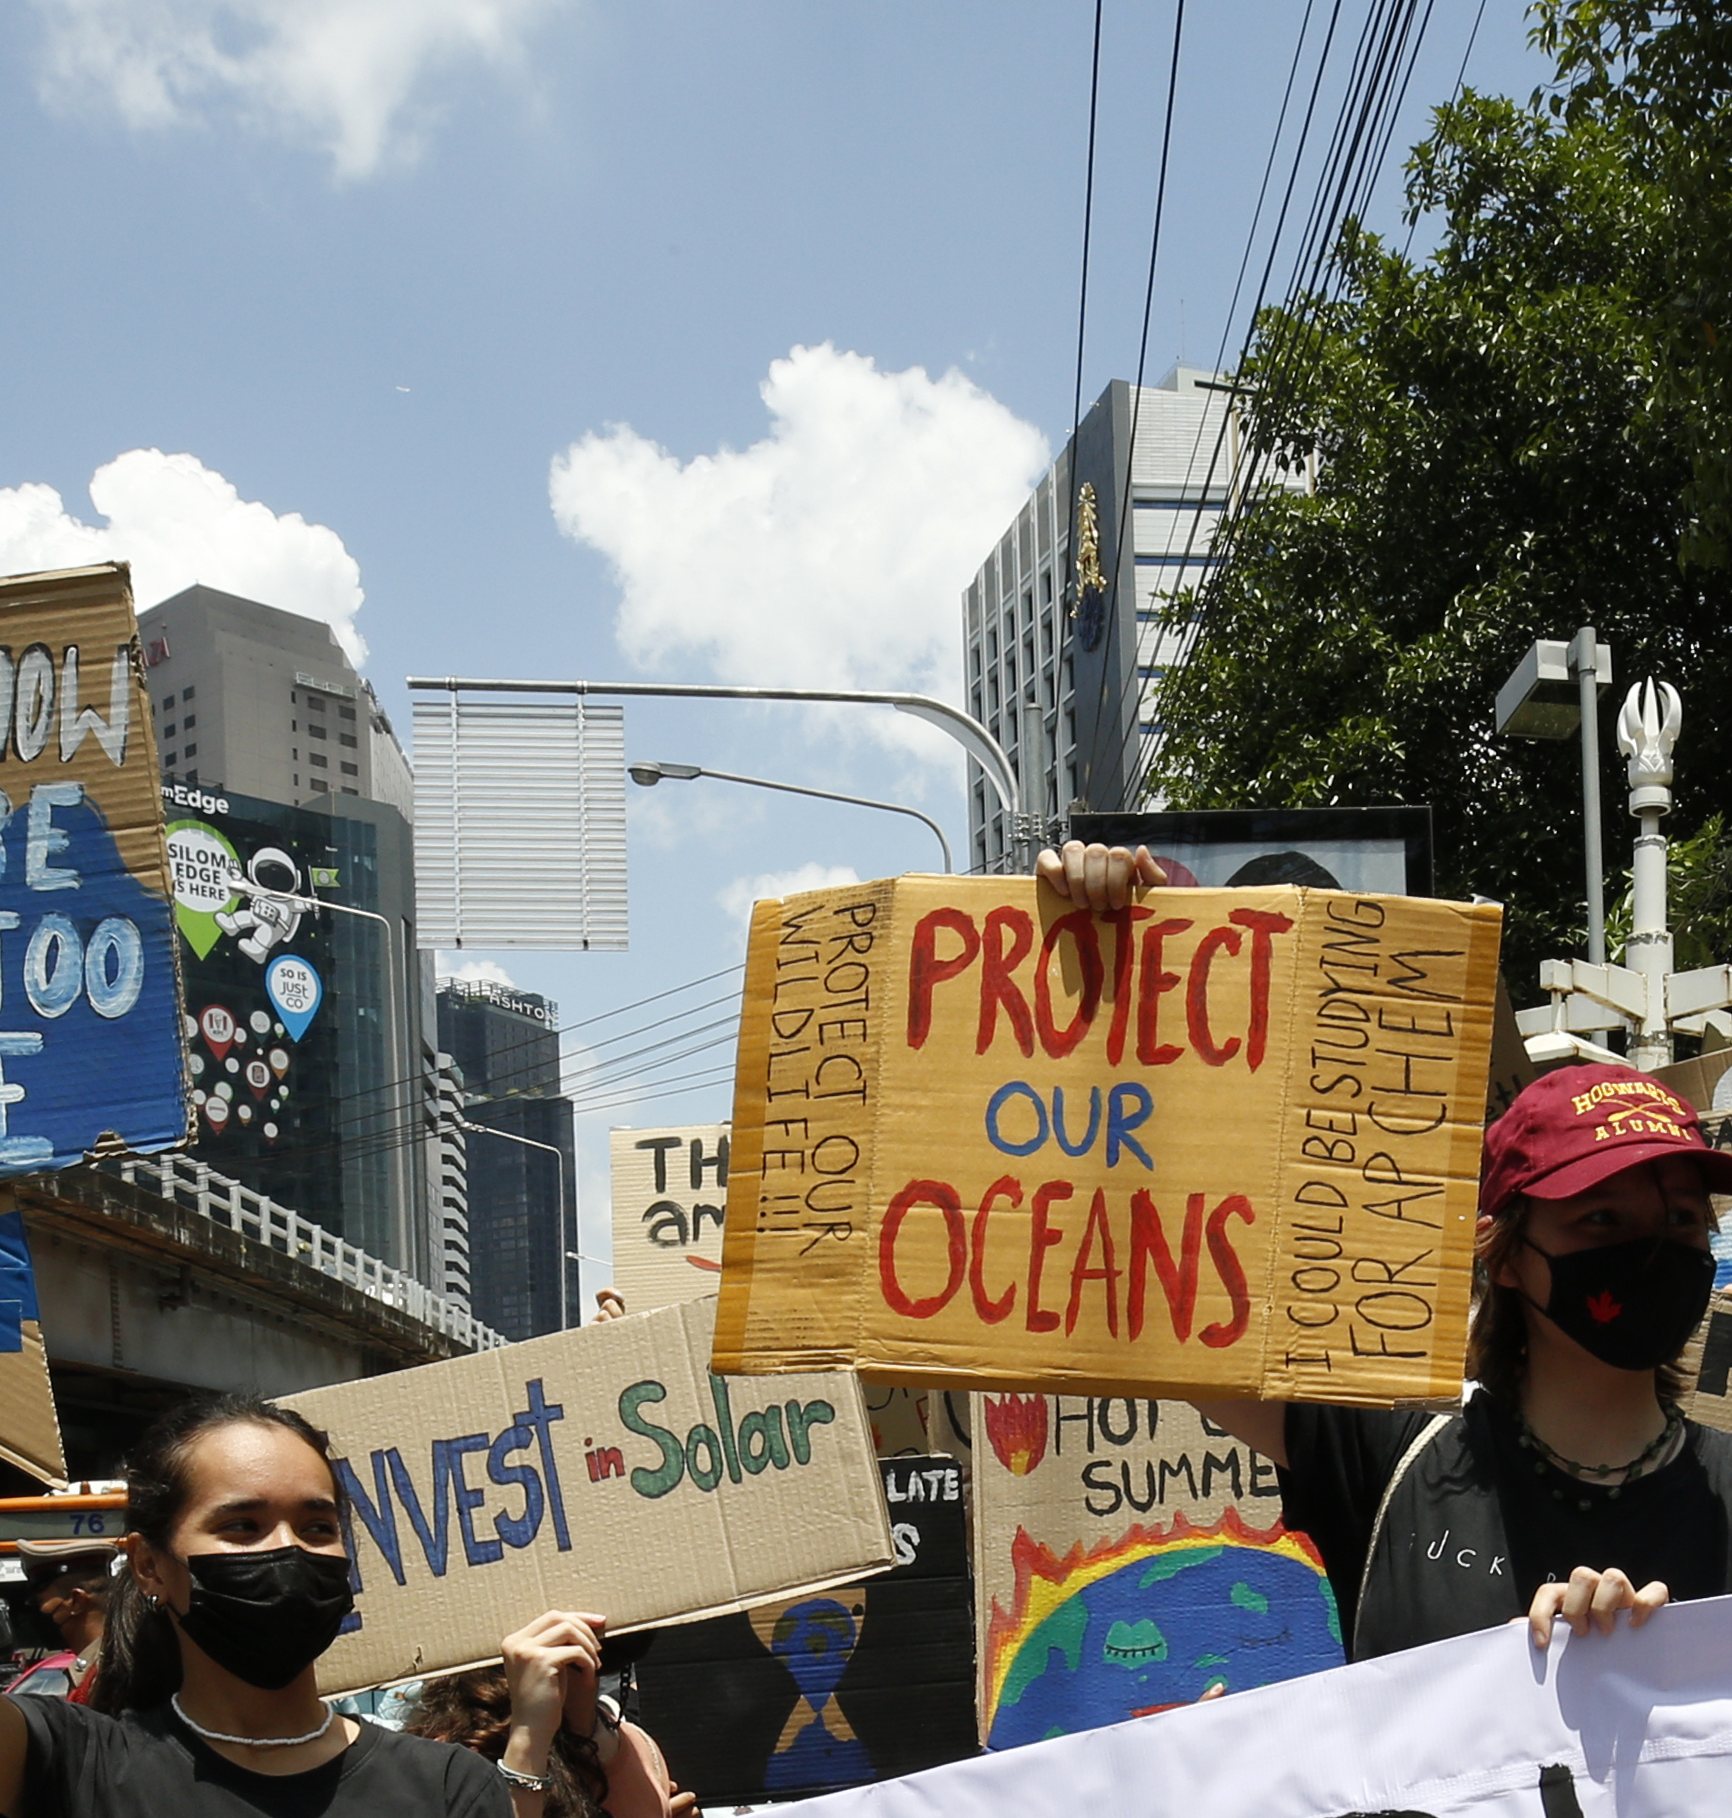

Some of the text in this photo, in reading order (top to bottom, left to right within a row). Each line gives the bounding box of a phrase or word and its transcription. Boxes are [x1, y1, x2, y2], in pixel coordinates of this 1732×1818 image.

[168, 843, 226, 869] SILOM
[175, 862, 222, 886] EDGE
[189, 882, 226, 902] HERE
[279, 967, 308, 982] SO IS
[906, 904, 1295, 1074] PROTECT
[1311, 899, 1386, 1102] STUDYING
[488, 992, 559, 1024] ASHTON
[755, 902, 828, 1236] WILDLIFE!!!
[798, 902, 877, 1258] PROTECT OUR
[1571, 1082, 1687, 1116] HOGWARTS
[984, 1080, 1156, 1171] OUR
[1302, 1108, 1357, 1165] BE
[1595, 1119, 1692, 1141] ALUMNI
[1348, 946, 1466, 1359] FOR AP CHEM
[877, 1174, 1257, 1350] OCEANS
[1287, 1179, 1350, 1329] COULD
[584, 1436, 626, 1484] in
[618, 1373, 836, 1500] Solar
[885, 1468, 960, 1503] LATE
[69, 1513, 106, 1536] 76
[1409, 1529, 1505, 1576] UCK
